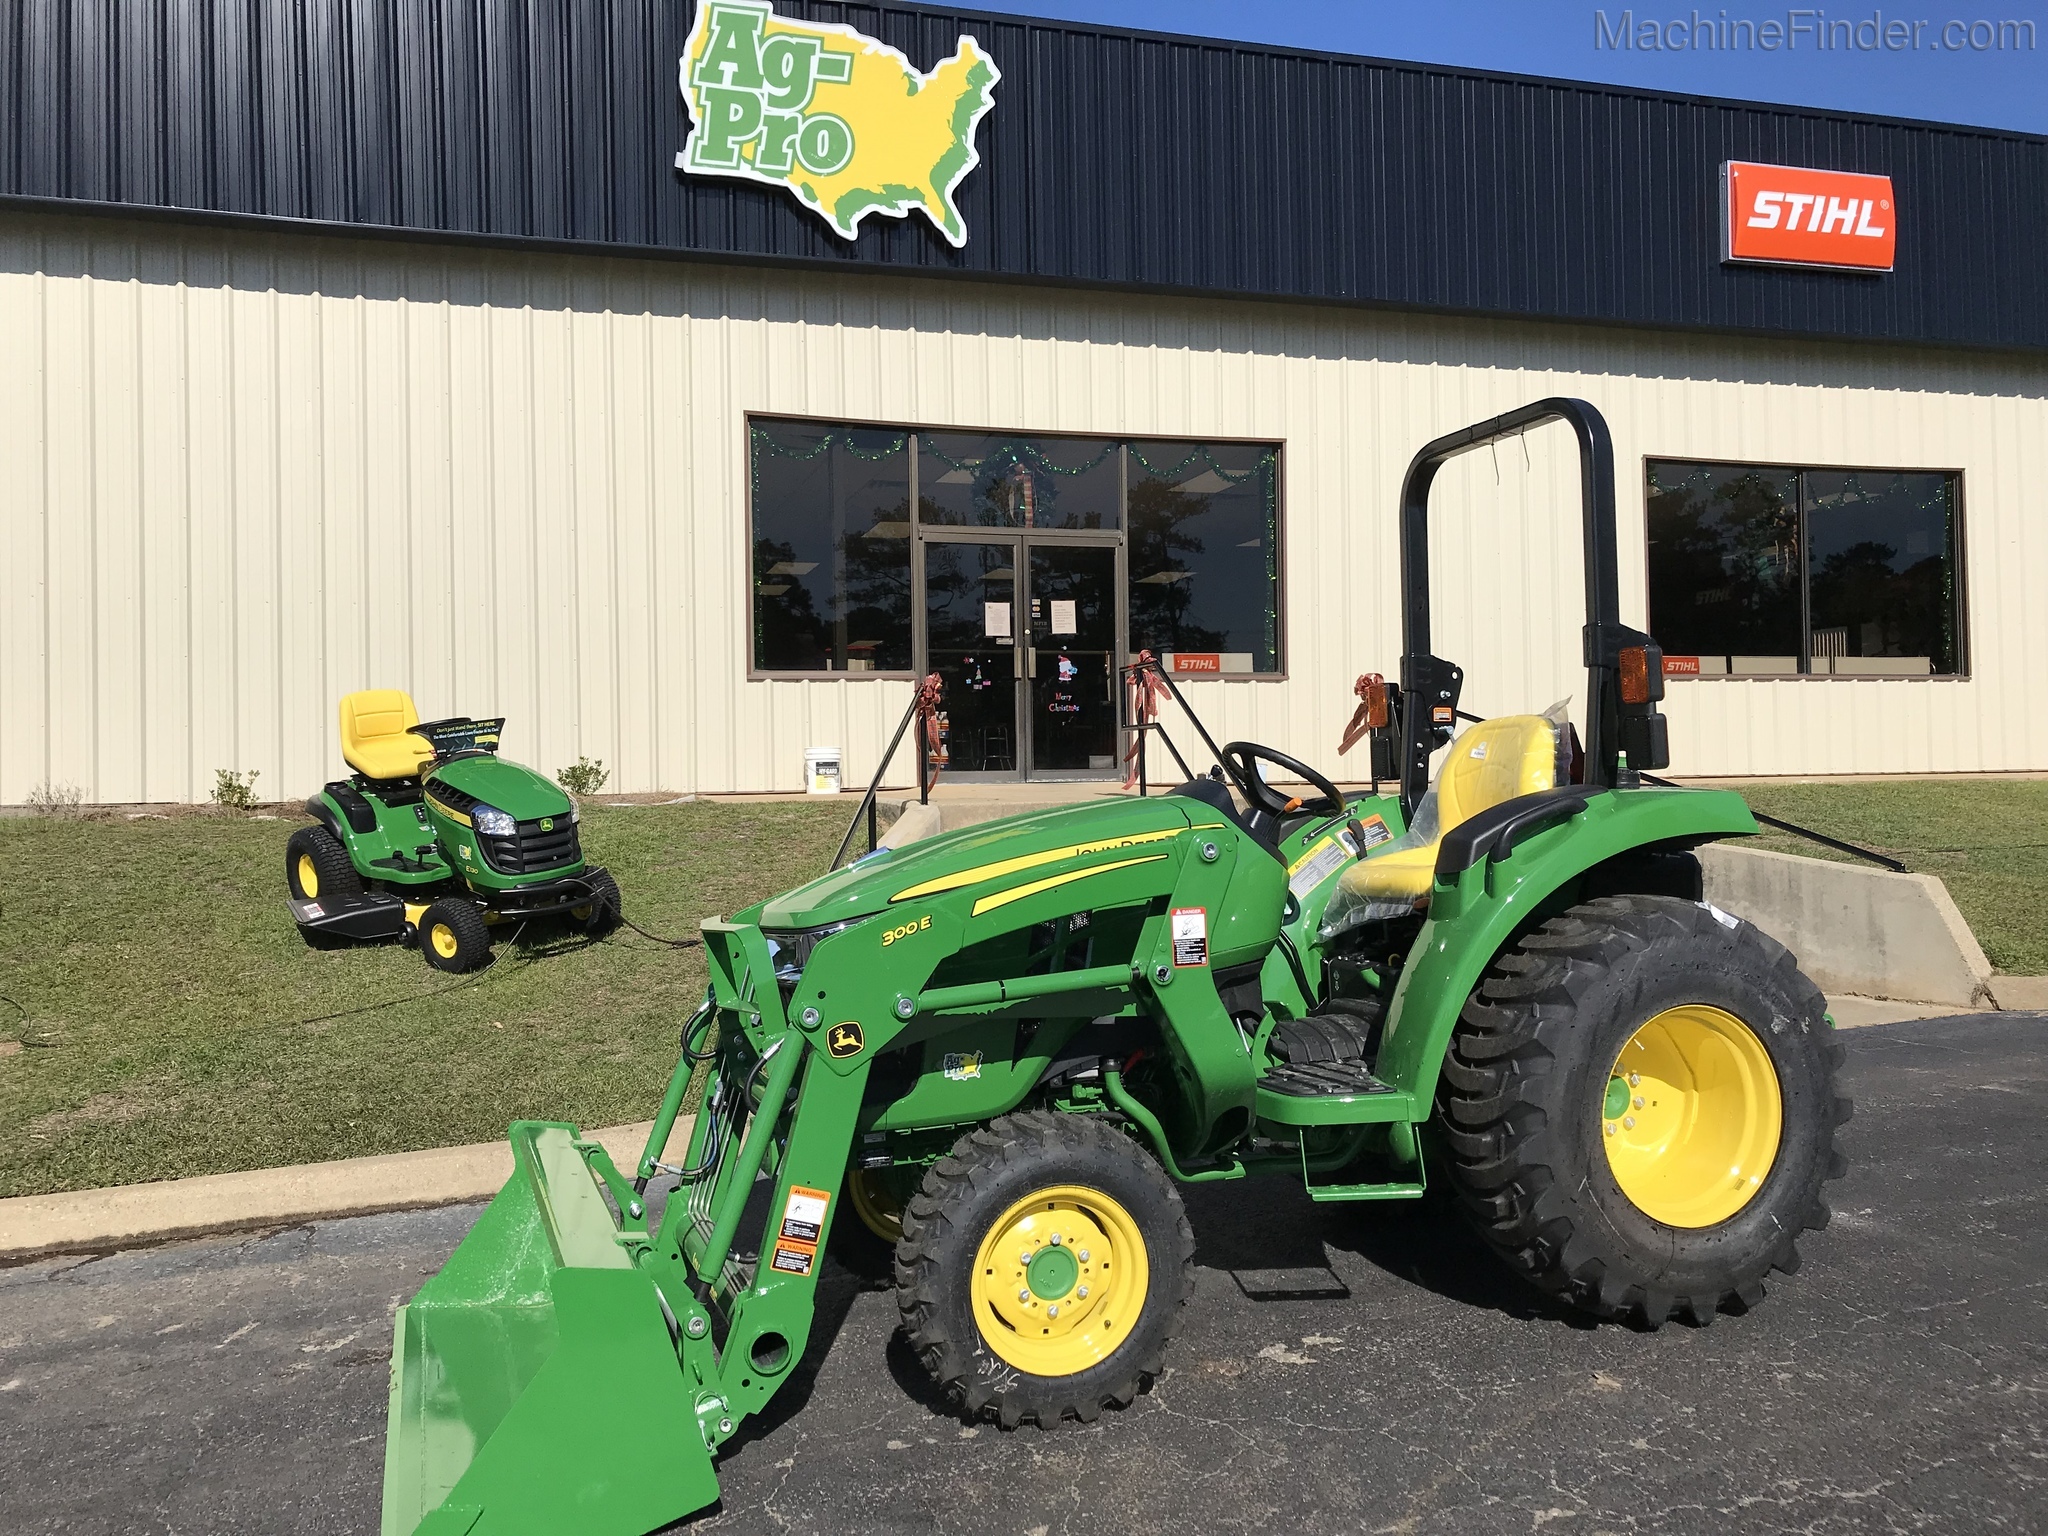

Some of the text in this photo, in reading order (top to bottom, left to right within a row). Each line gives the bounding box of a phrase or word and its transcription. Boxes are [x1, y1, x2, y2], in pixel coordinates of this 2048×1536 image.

[693, 6, 852, 111] Ag-
[692, 88, 854, 173] Pro
[1747, 190, 1885, 237] STIHL
[1179, 659, 1217, 670] STIHL
[1667, 661, 1698, 671] STIHL
